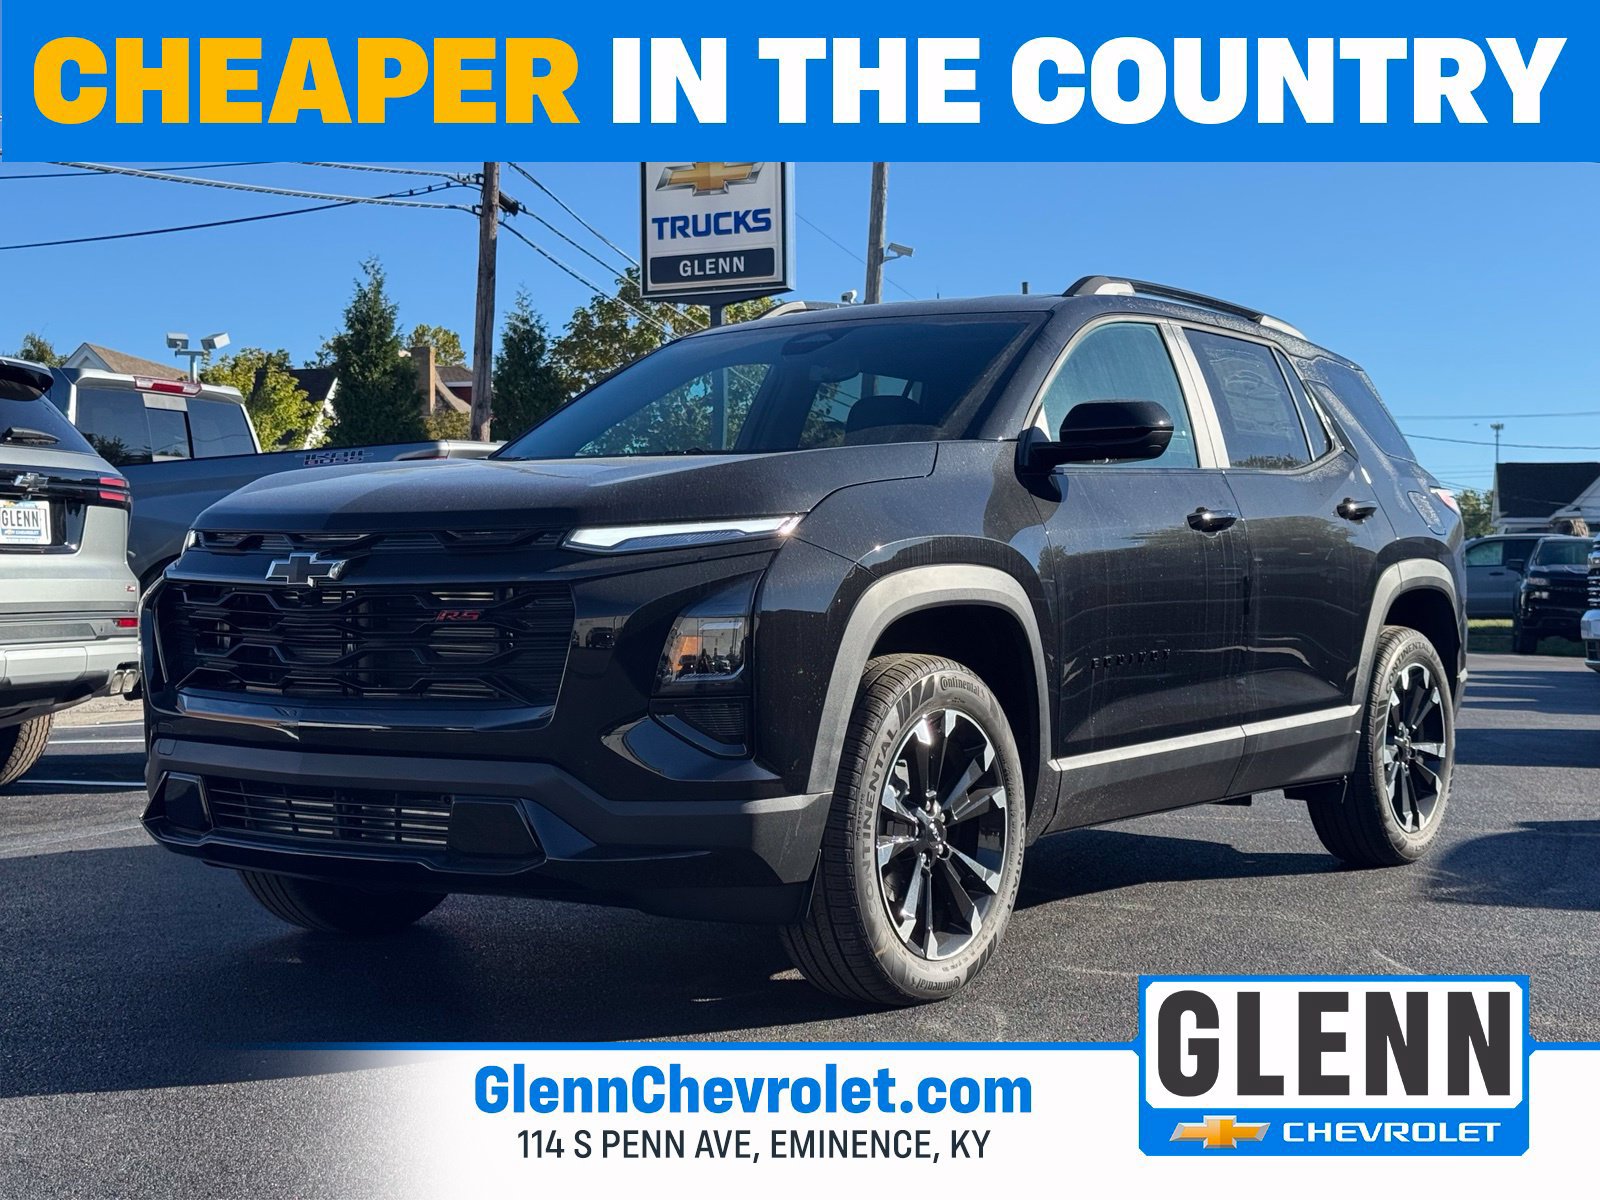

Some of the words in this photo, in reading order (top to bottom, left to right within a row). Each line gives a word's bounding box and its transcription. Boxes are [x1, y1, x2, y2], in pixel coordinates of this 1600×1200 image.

[651, 208, 772, 240] TRUCKS
[679, 256, 745, 277] GLENN
[1, 509, 40, 528] GLENN
[435, 609, 481, 622] RS
[1385, 641, 1431, 695] CONTINENTAL
[940, 675, 981, 698] Continental
[862, 728, 898, 918] CONTINENTAL
